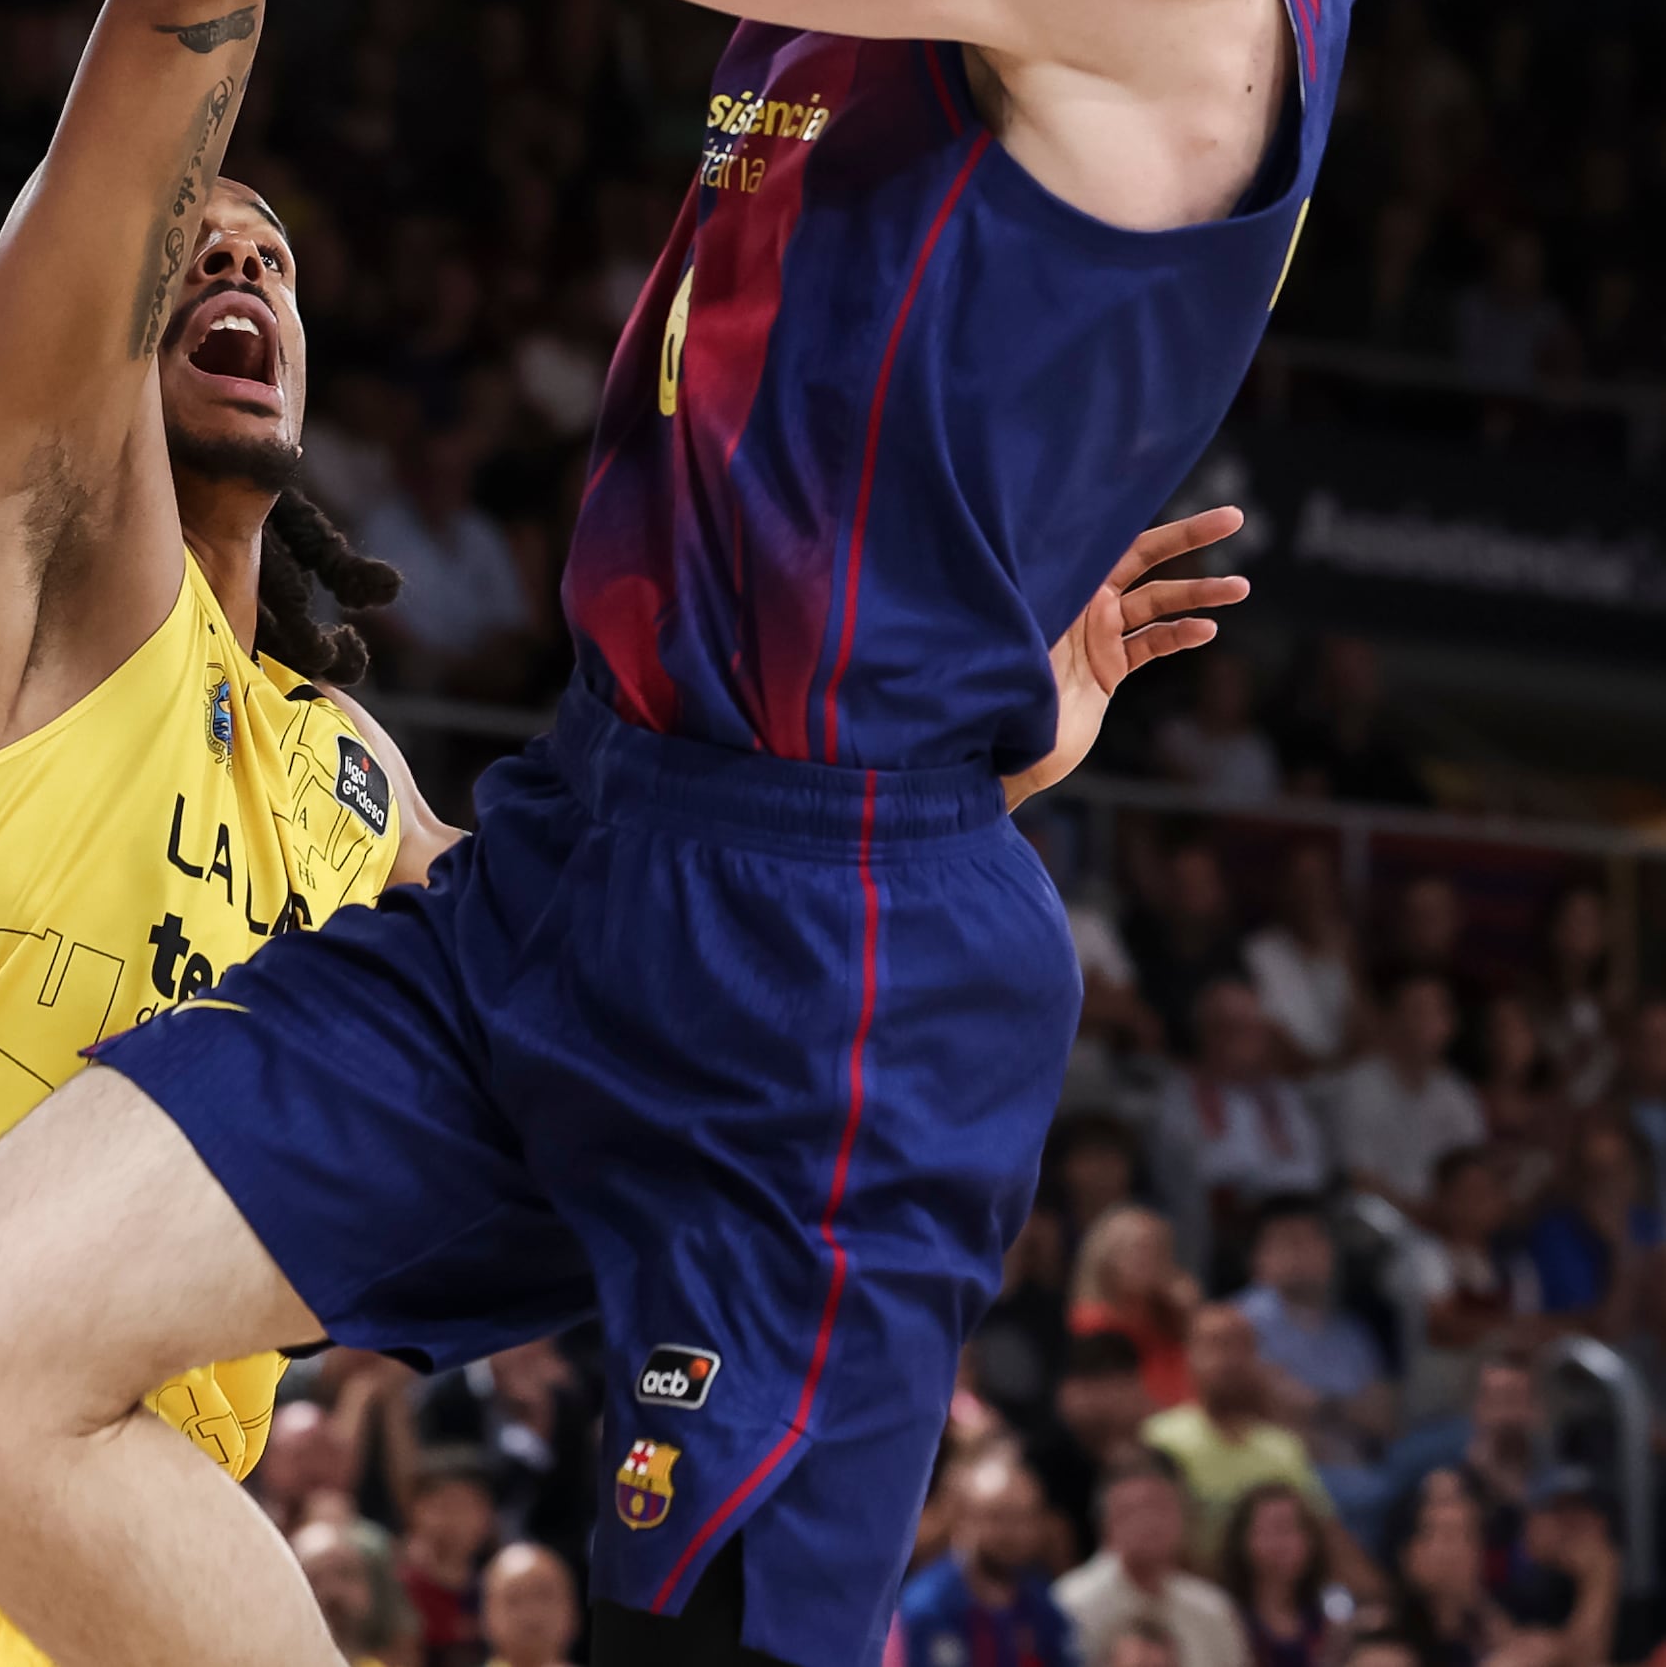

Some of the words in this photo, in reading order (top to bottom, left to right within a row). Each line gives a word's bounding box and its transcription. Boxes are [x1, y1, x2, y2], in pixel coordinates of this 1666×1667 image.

[344, 755, 367, 787] liga
[342, 779, 385, 827] endesa
[166, 792, 234, 907] LA
[148, 912, 226, 1004] te
[642, 1367, 689, 1398] acb
